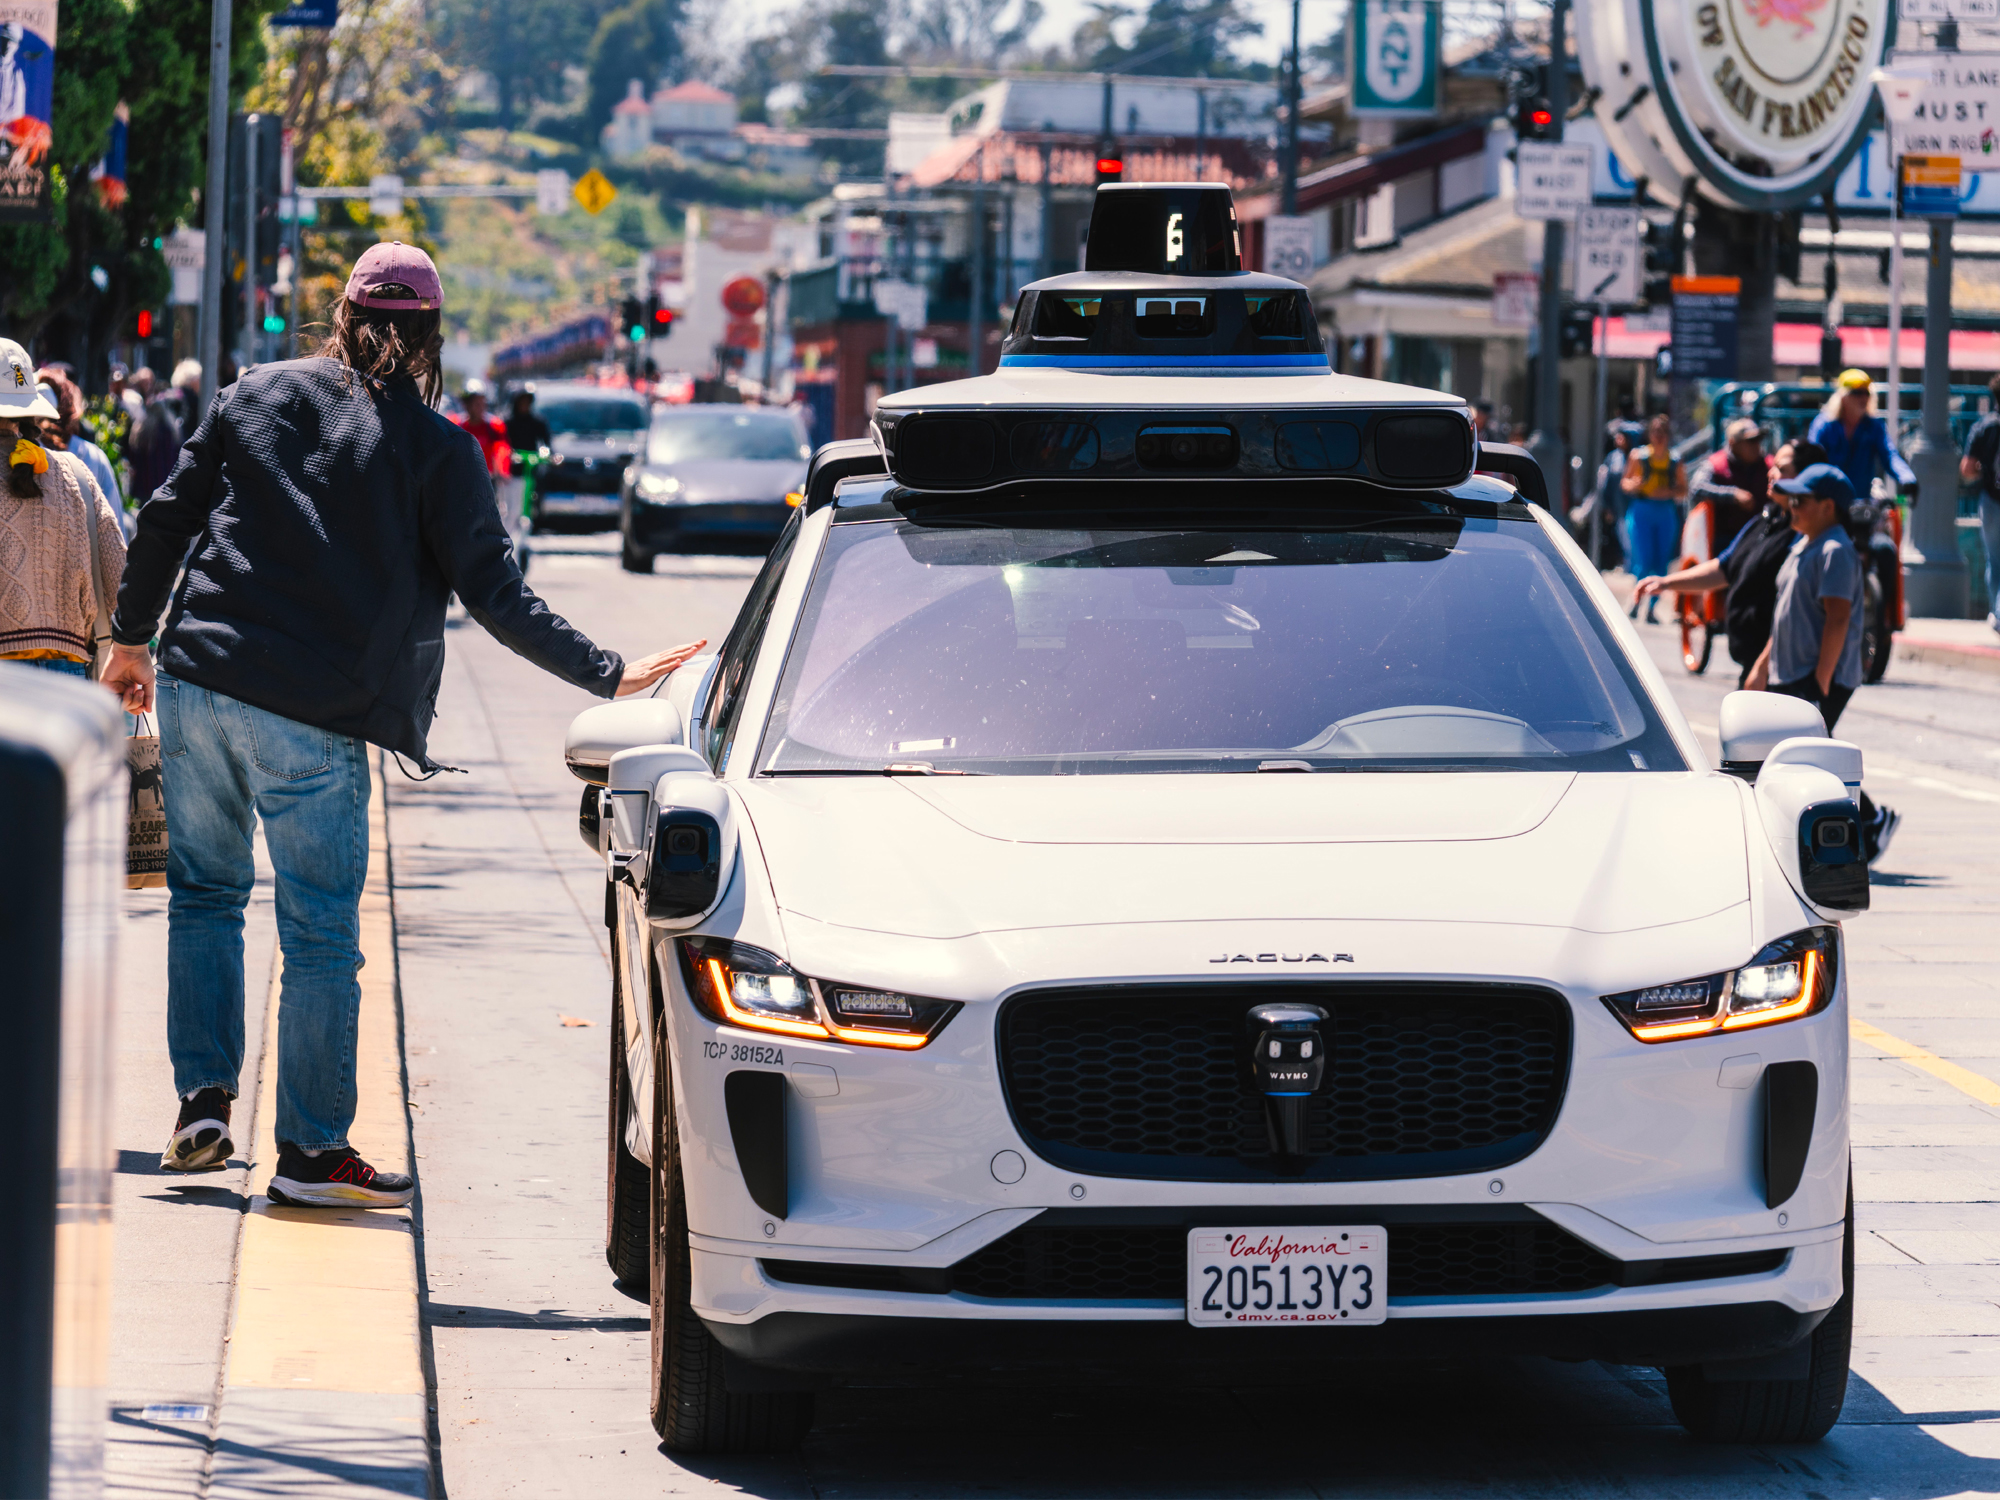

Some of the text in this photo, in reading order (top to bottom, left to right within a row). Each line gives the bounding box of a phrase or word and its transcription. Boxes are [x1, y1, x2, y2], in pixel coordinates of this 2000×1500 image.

[1698, 4, 1869, 138] OF SAN FRANCISCO
[1954, 69, 2000, 88] LANE
[1905, 134, 1942, 152] URN
[1584, 212, 1631, 230] STOP
[140, 820, 168, 832] EARE
[128, 832, 162, 847] BOOKS
[132, 848, 169, 860] FRANCISC
[1209, 952, 1355, 964] JAGUAR
[703, 1041, 784, 1066] TCP 38152A
[1269, 1072, 1309, 1080] WAYMO
[1230, 1234, 1351, 1264] California
[1202, 1264, 1373, 1311] 20513Y3
[1237, 1312, 1338, 1322] dmv.ca.gov
